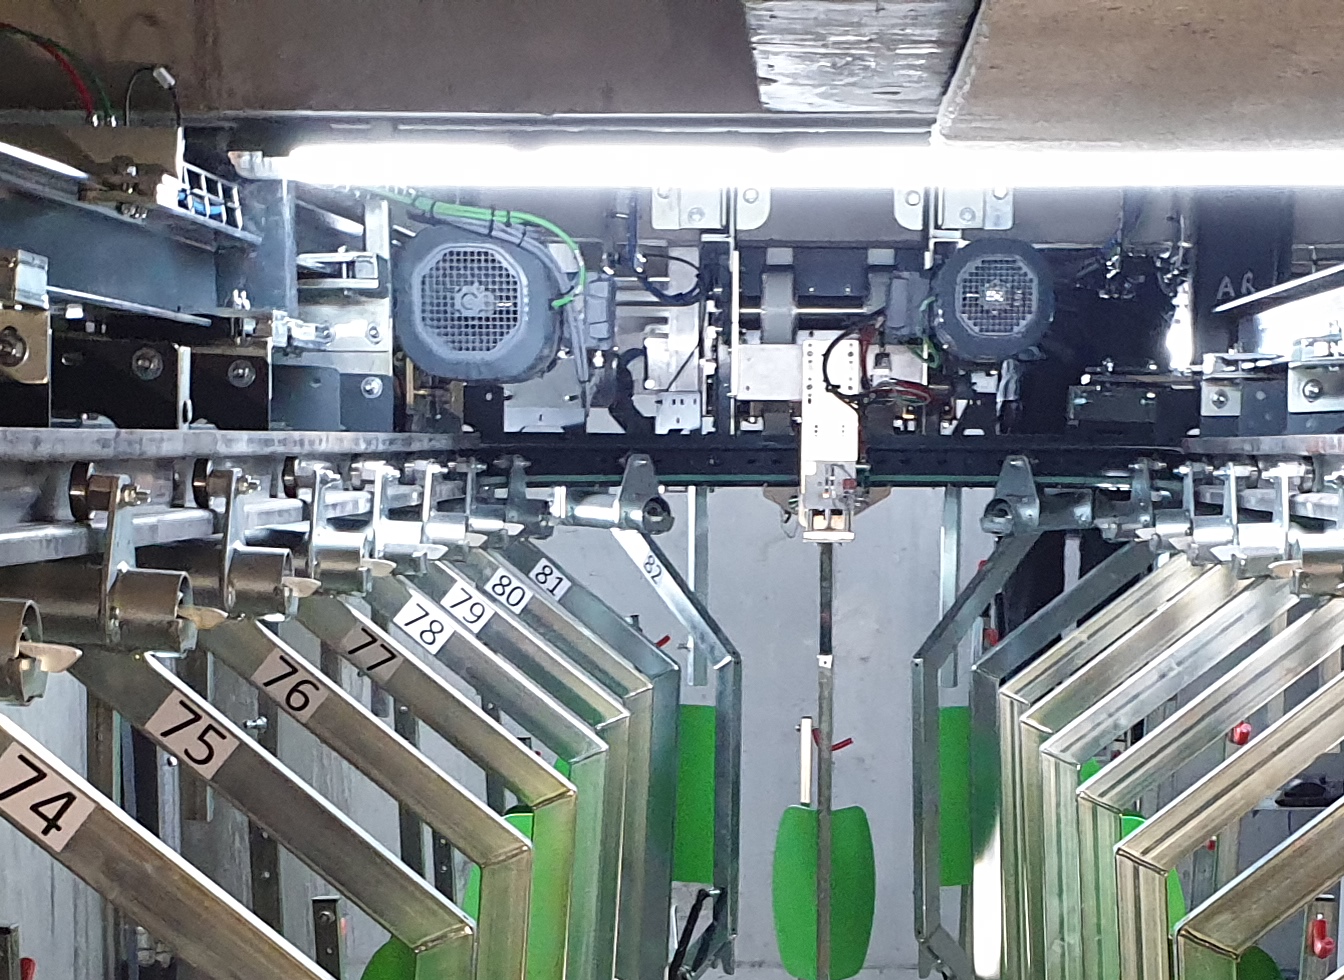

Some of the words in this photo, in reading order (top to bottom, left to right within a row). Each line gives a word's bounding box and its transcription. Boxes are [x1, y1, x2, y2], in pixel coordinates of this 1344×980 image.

[535, 564, 563, 596] 81
[643, 554, 662, 585] 82
[448, 587, 485, 624] 79
[491, 574, 526, 607] 80
[402, 604, 445, 645] 78
[347, 628, 397, 671] 77
[262, 655, 320, 712] 76
[160, 700, 227, 765] 75
